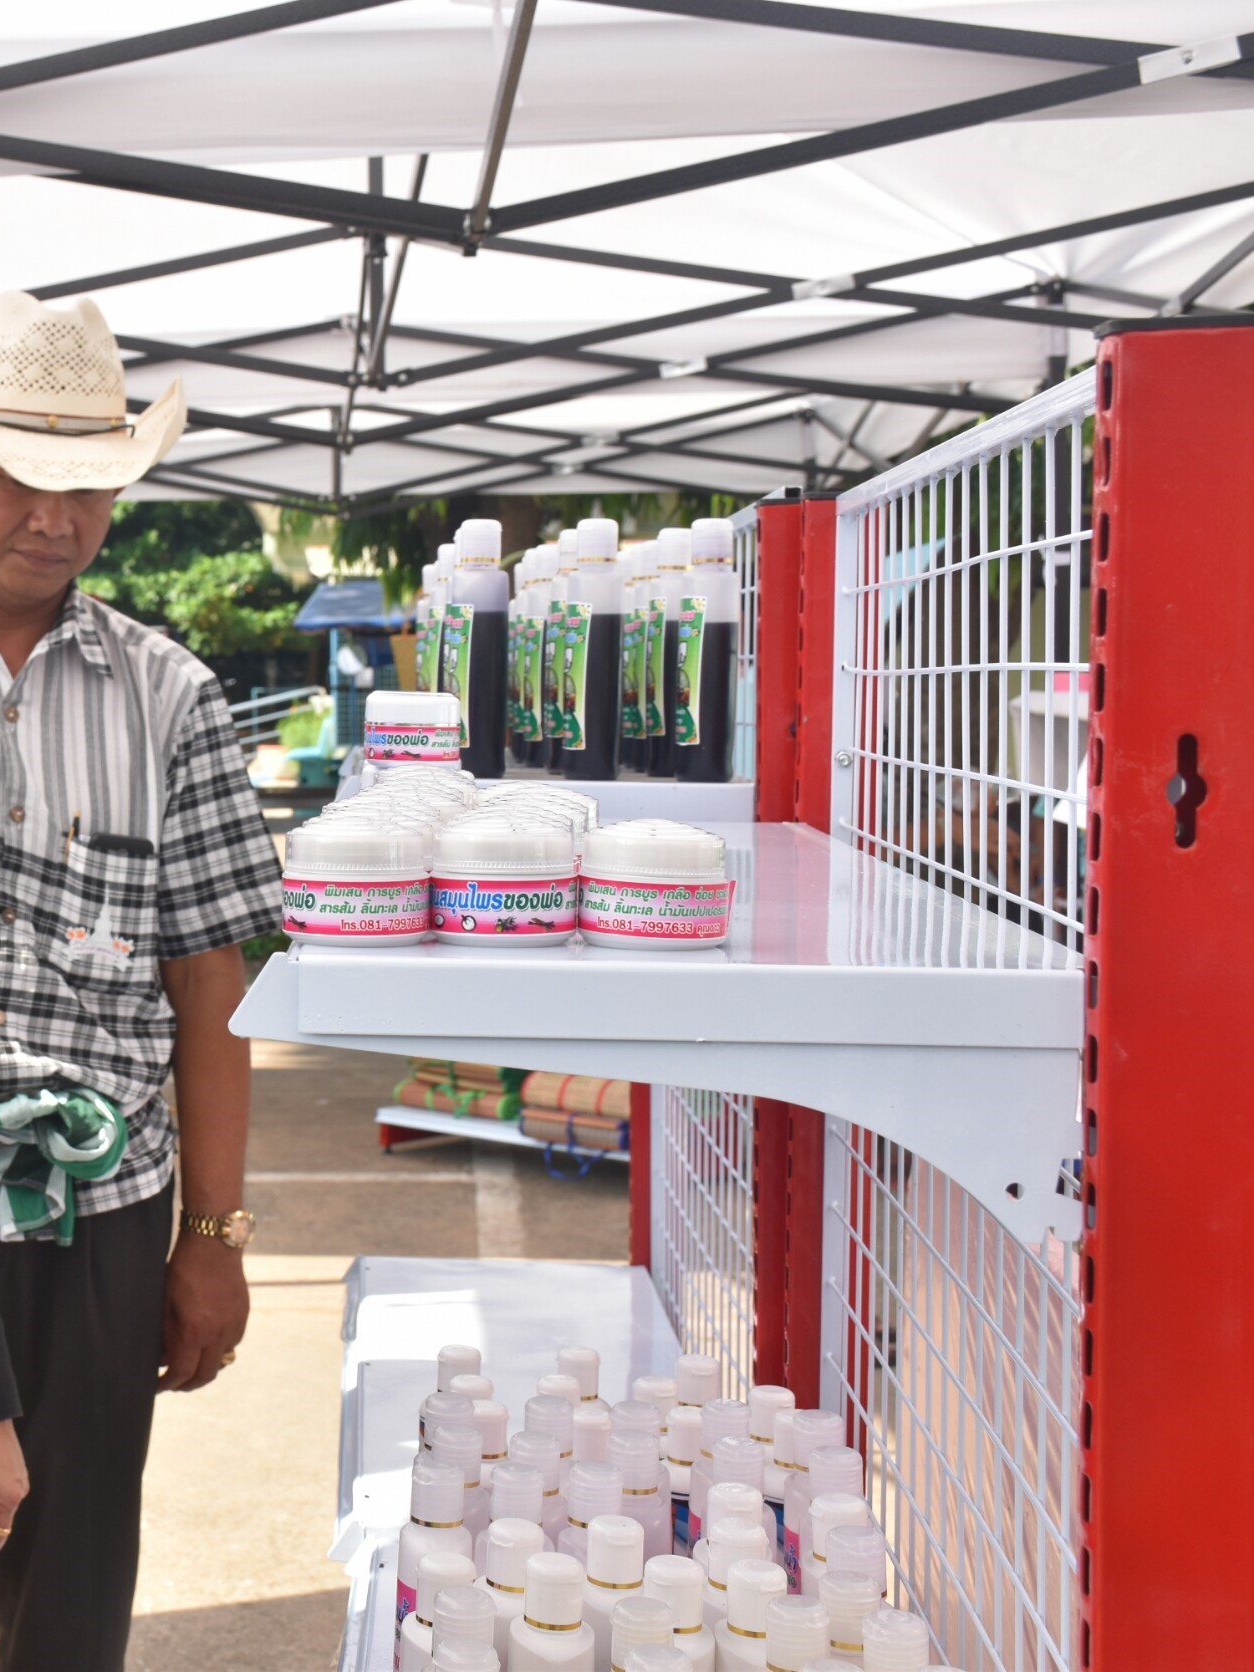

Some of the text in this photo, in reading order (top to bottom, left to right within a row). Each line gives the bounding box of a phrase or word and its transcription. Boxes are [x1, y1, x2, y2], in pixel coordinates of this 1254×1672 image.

[367, 885, 401, 900] การบูร
[621, 888, 657, 902] การบูร
[663, 886, 691, 900] เกลือ
[319, 901, 356, 914] สารส้ม
